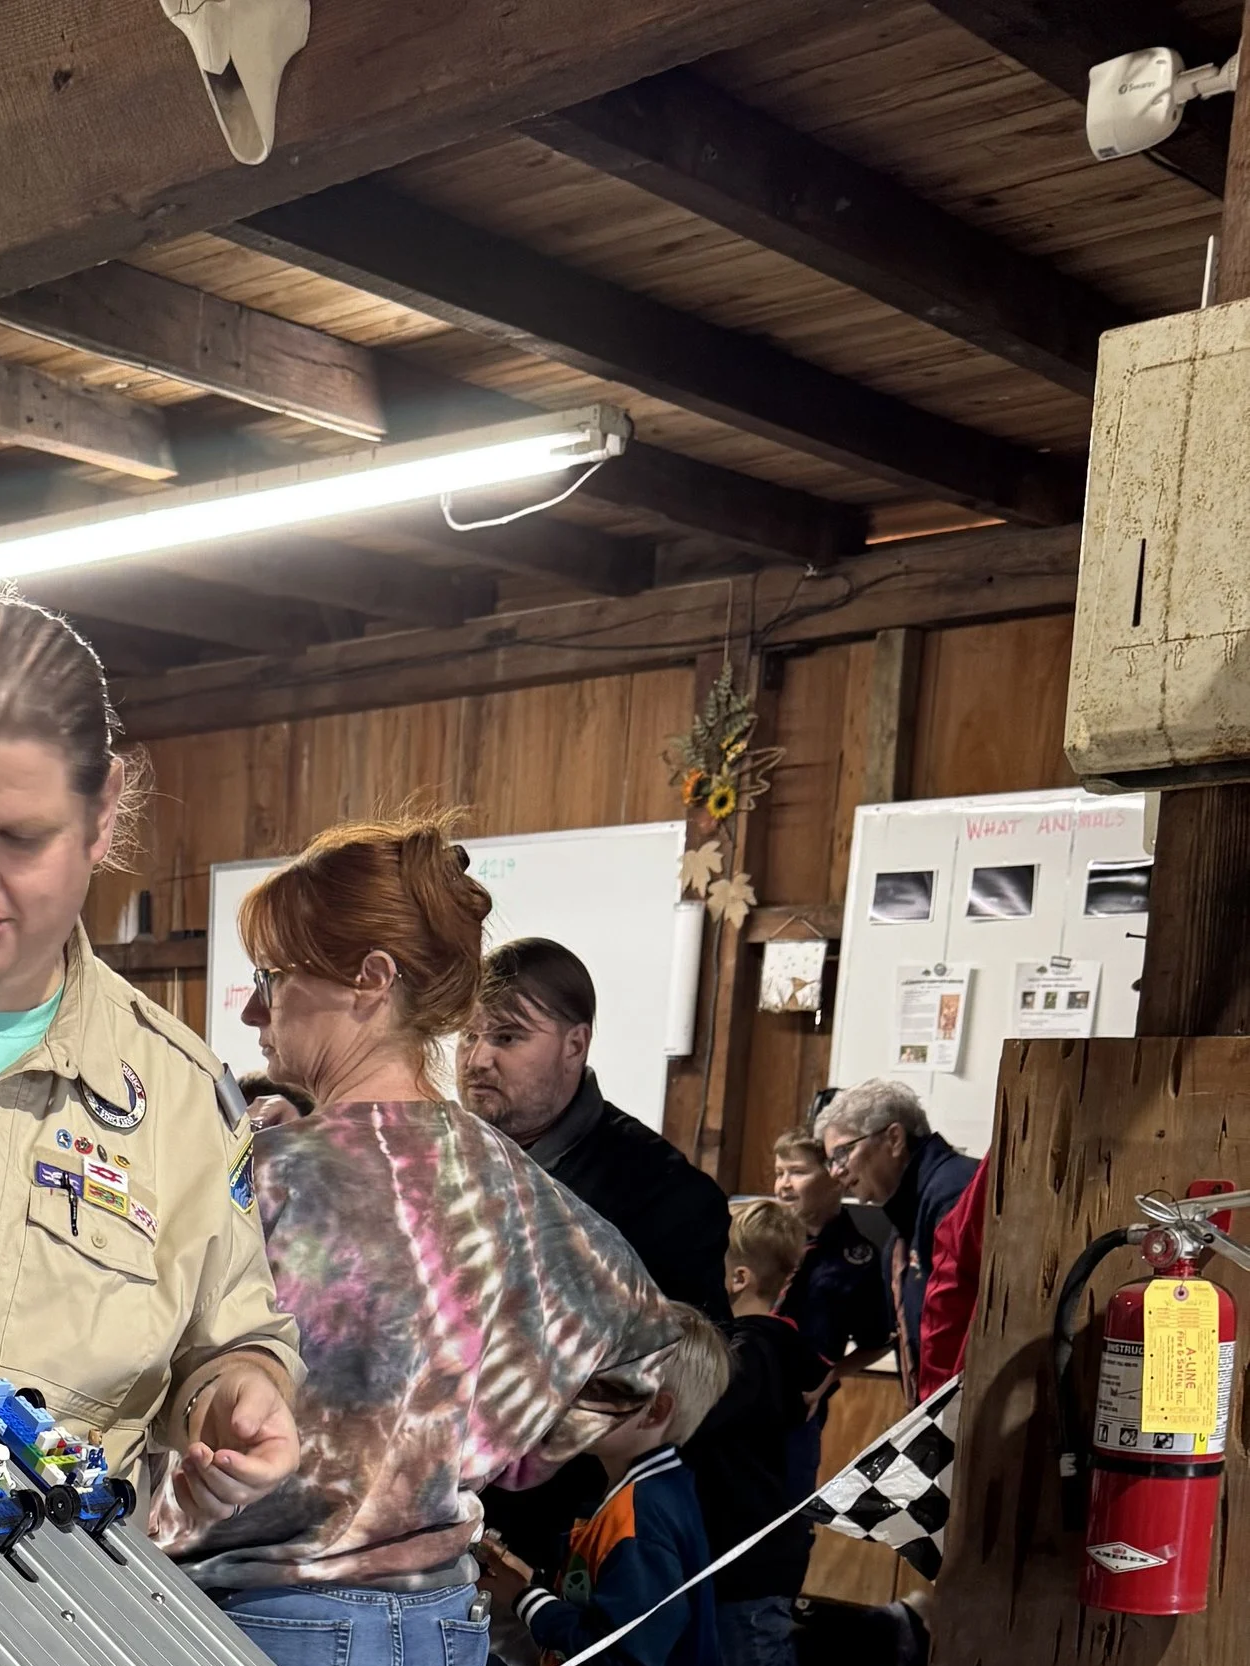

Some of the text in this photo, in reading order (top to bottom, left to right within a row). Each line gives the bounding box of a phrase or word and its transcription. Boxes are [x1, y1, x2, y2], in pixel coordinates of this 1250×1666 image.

[965, 810, 1127, 841] WHAT ANIMALS
[1107, 1341, 1144, 1355] INSTRUC
[1176, 1330, 1185, 1347] Fire
[1185, 1347, 1197, 1390] A-LINE
